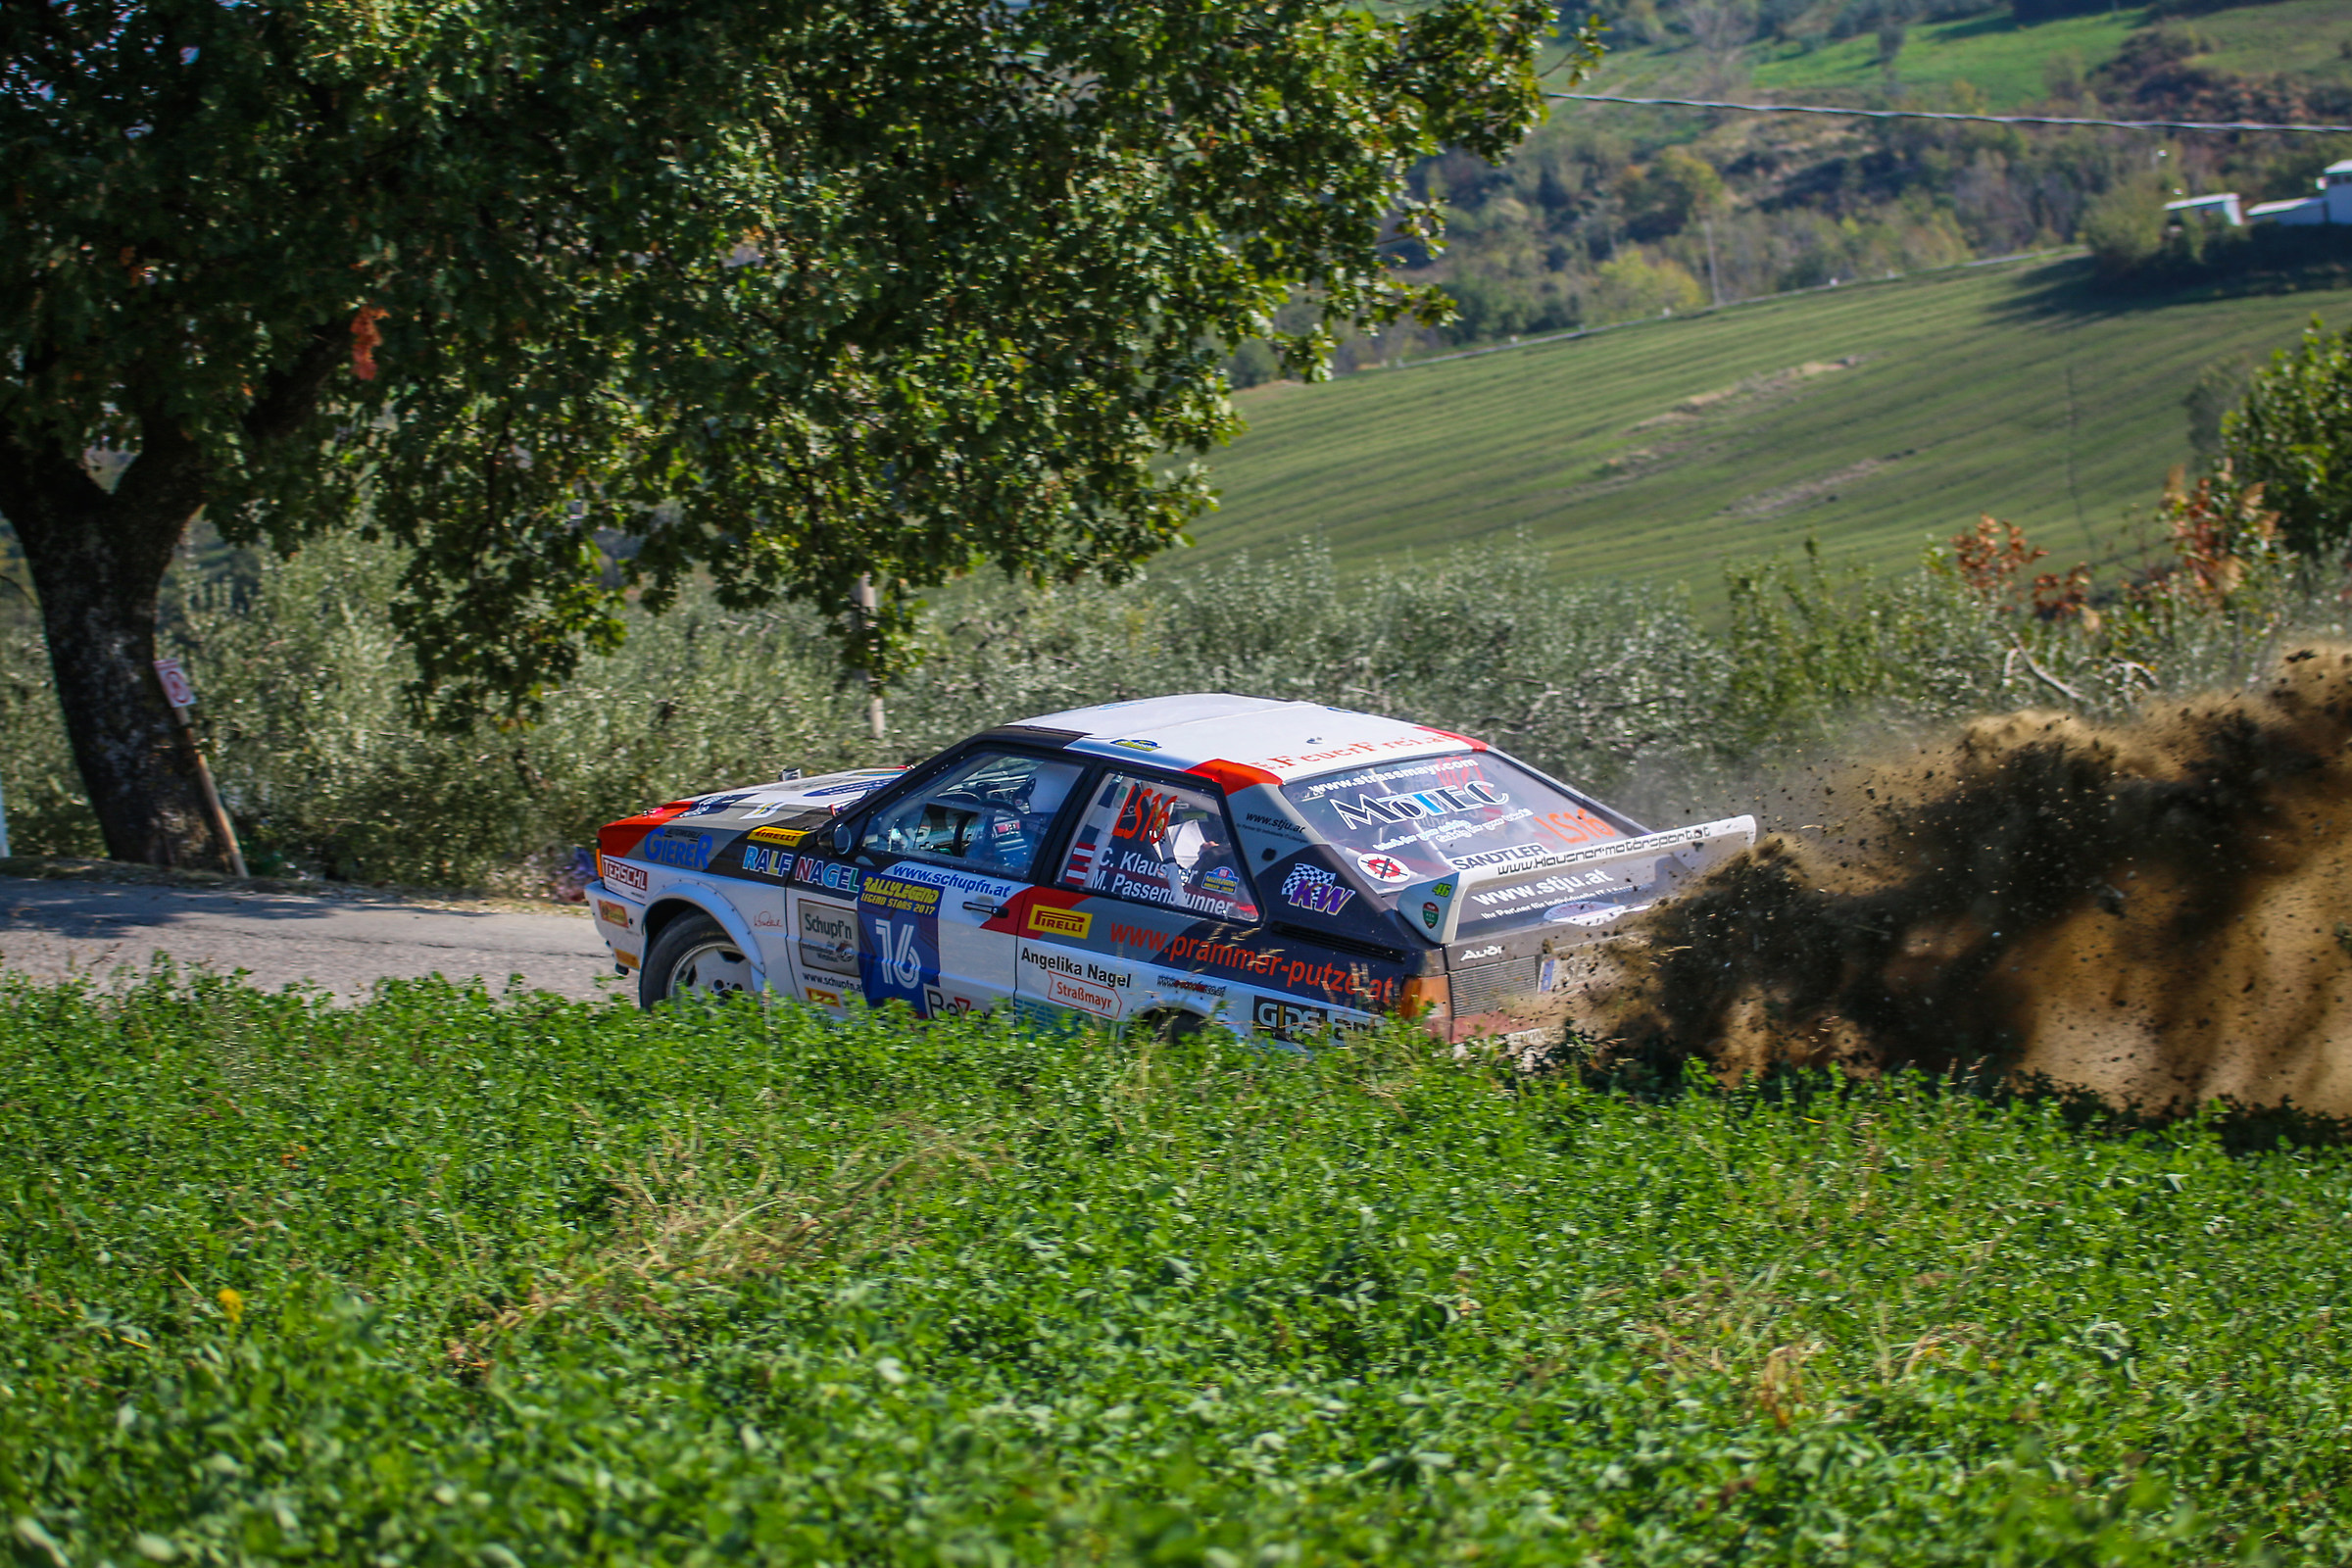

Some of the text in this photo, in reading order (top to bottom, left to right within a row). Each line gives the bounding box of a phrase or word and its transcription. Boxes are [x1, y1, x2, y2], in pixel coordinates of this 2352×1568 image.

[1308, 758, 1478, 795] www.strassmayr.com
[1111, 785, 1178, 845] LS16
[1246, 812, 1306, 833] www.stju.at
[644, 827, 713, 869] GIERER
[755, 828, 803, 842] PIRELLI
[742, 846, 859, 893] RALF NAGEL
[1119, 851, 1199, 884] Klausr
[1452, 844, 1548, 871] SANDTLER
[893, 865, 1011, 898] www.schupfn.at
[1111, 873, 1233, 915] Passenbunner
[1288, 878, 1356, 915] KW
[1432, 883, 1451, 897] 46
[1471, 868, 1615, 906] www.stju.at
[860, 893, 936, 915] LEGEND STARS 2017
[1034, 909, 1086, 932] PIRELLI
[1481, 911, 1497, 920] Ihr
[875, 918, 921, 990] 16
[1021, 947, 1132, 989] Angelika Nagel
[1110, 922, 1394, 1004] www.prammer-putze.at
[1056, 981, 1112, 1010] Straßmayr
